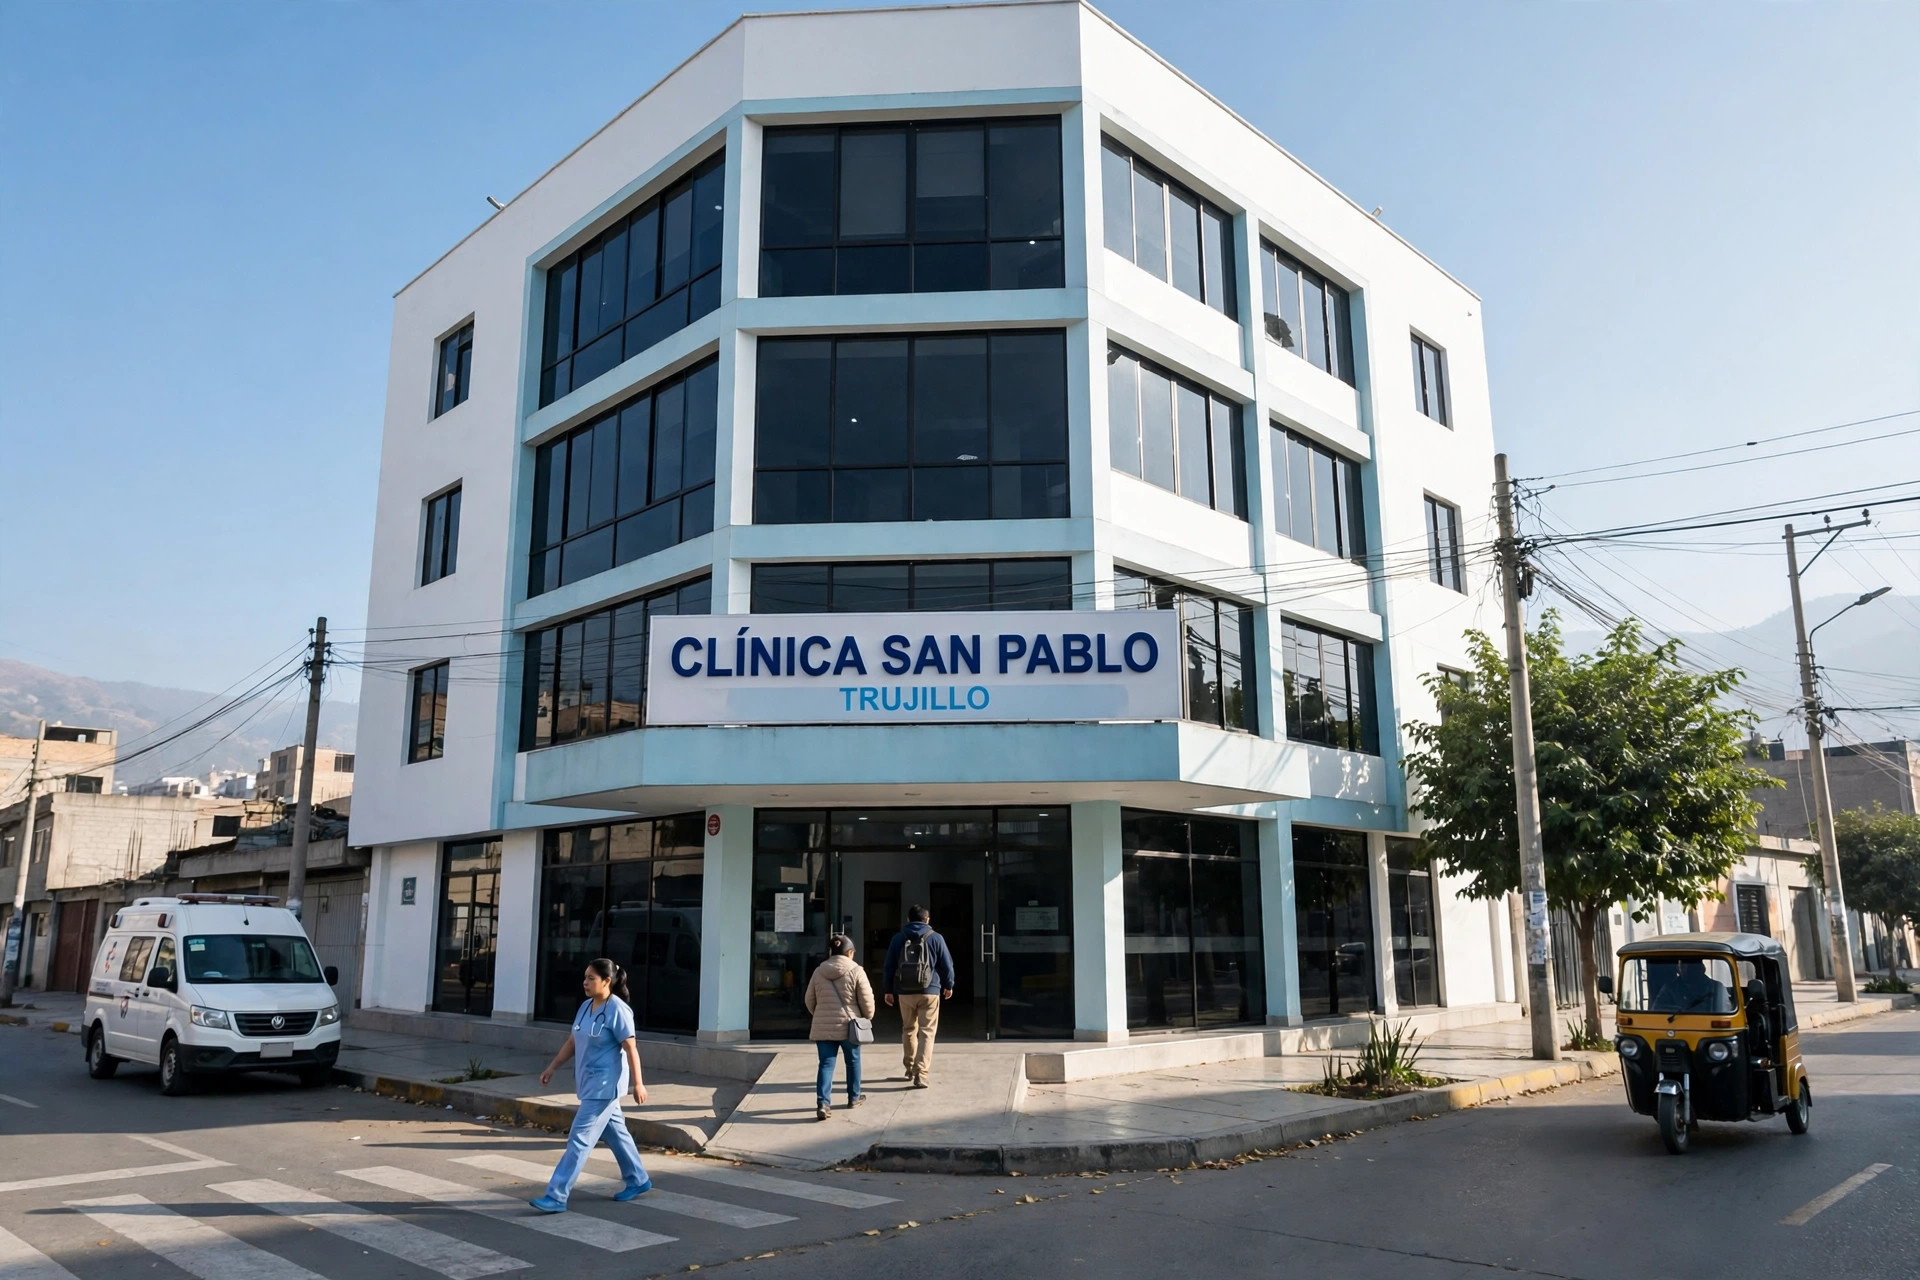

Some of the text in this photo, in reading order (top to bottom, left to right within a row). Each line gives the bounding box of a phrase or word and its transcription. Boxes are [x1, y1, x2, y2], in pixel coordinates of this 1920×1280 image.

[670, 626, 1159, 678] CLÍNICA SAN PABLO
[839, 685, 990, 712] TRUJILLO
